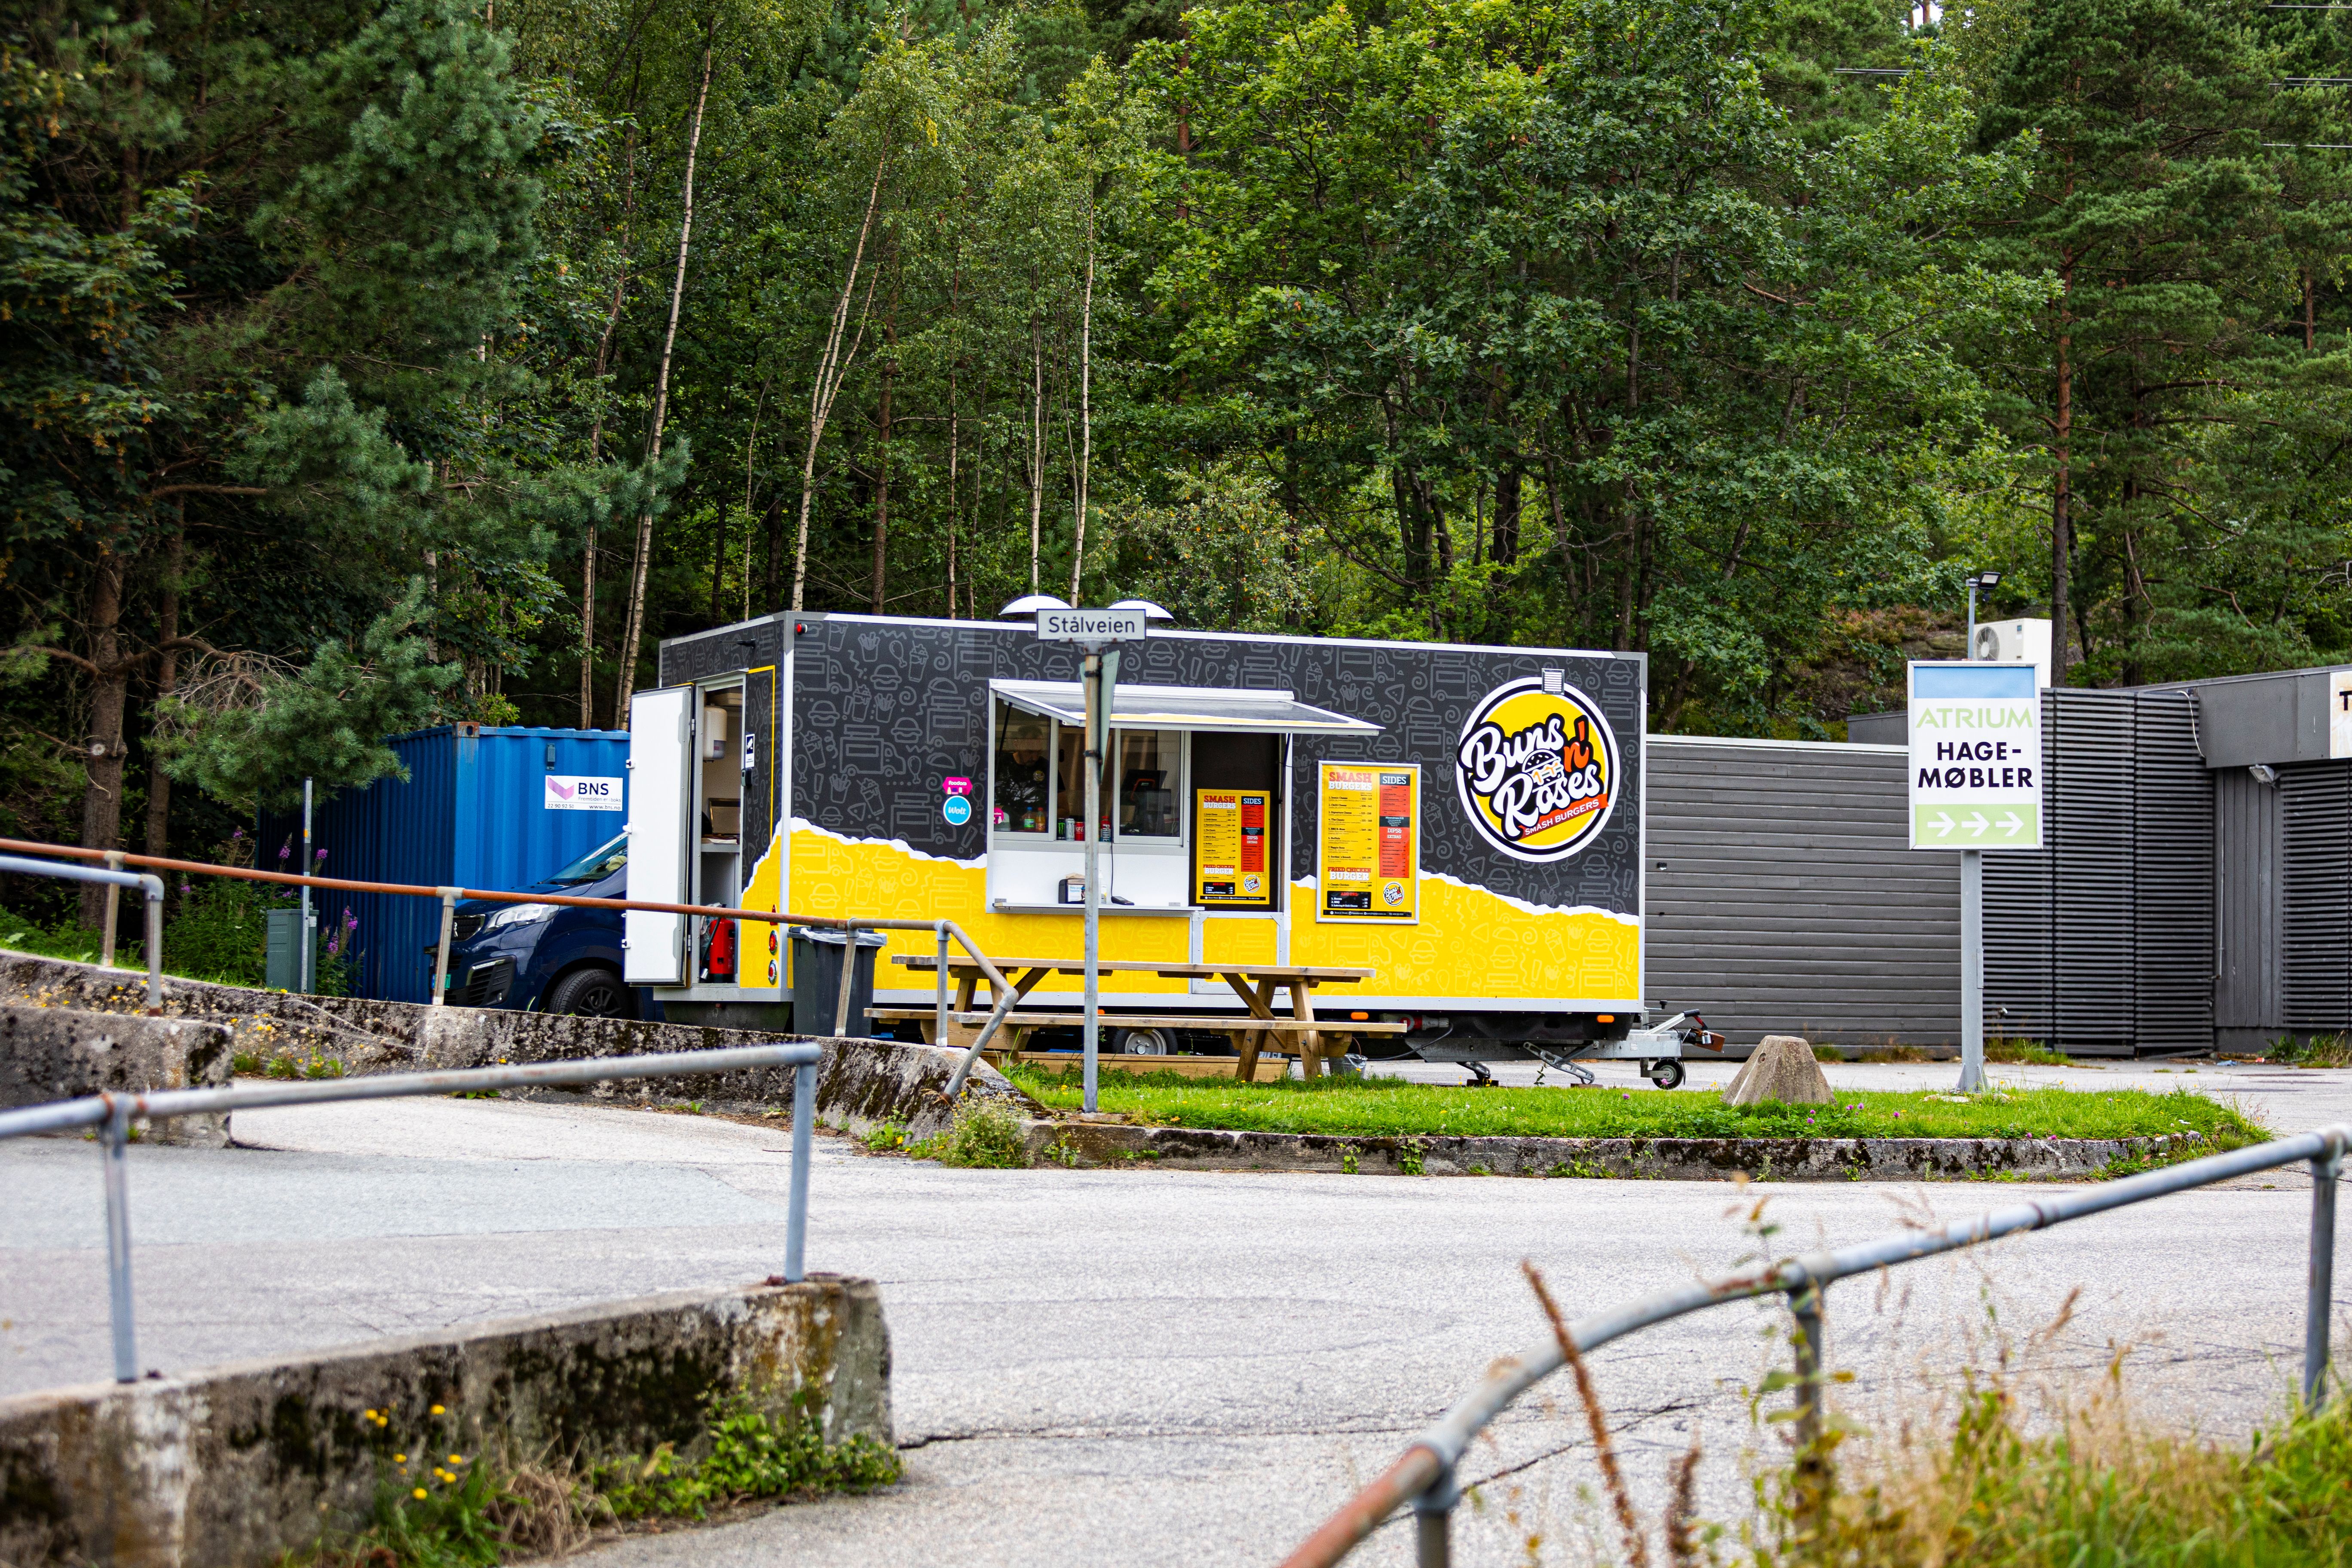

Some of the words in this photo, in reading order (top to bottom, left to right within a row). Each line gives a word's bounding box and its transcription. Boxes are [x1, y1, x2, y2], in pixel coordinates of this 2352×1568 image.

[1049, 616, 1135, 633] Stålveien
[1916, 707, 2033, 728] ATRIUM
[1461, 718, 1564, 793] Buns
[1937, 741, 2021, 761] HAGE-
[1329, 772, 1372, 782] SMASH
[1382, 776, 1406, 784] SIDES
[1918, 767, 2034, 788] MØBLER
[579, 782, 609, 795] BNS
[1329, 781, 1372, 791] BURGERS
[1494, 764, 1600, 837] Roses
[948, 806, 966, 815] Wolt
[1525, 818, 1554, 835] SMASH
[1555, 799, 1599, 823] BURGERS
[1329, 871, 1369, 881] BURGER
[1384, 887, 1398, 897] Buns
[1388, 893, 1402, 903] Roses
